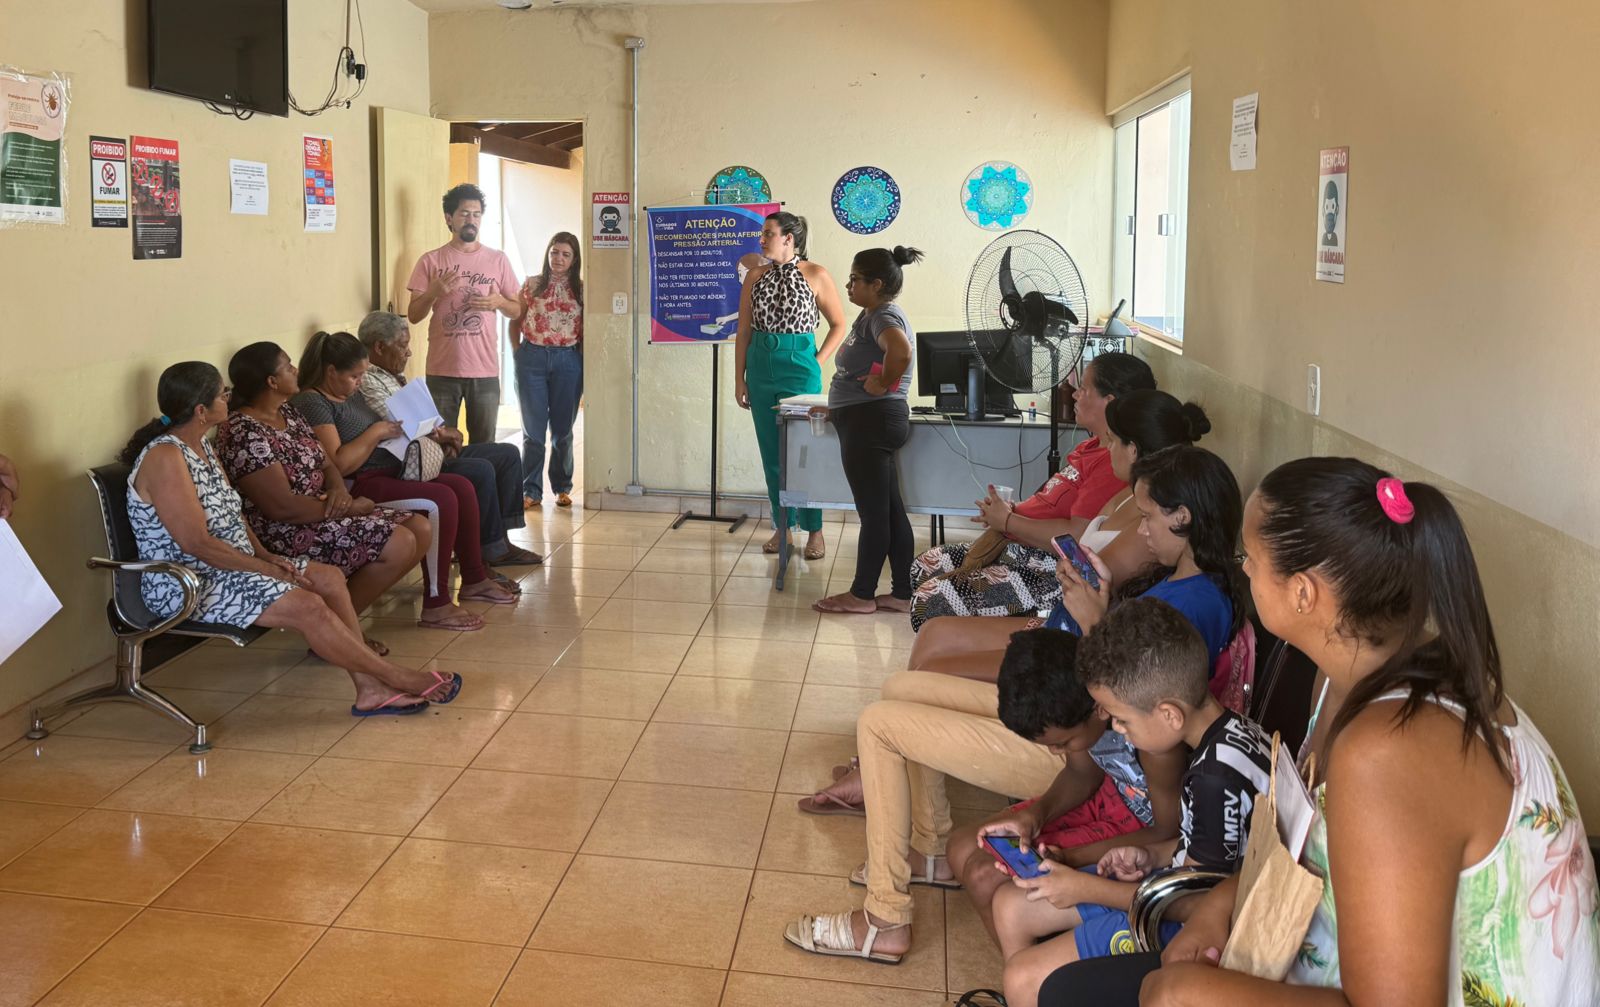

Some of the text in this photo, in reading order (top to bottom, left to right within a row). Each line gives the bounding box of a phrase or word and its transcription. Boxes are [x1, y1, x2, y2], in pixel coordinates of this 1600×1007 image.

[92, 143, 124, 156] PROIBIDO
[135, 144, 177, 156] PROIBIDO FUMAR
[99, 186, 120, 195] FUMAR
[594, 193, 629, 203] ATENÇÃO
[684, 217, 736, 230] ATENÇÃO
[654, 231, 717, 242] RECOMENDAÇÕES
[717, 232, 736, 240] PARA
[673, 239, 706, 248] PRESSÃO
[658, 293, 669, 301] NÃO
[1224, 788, 1240, 842] MRV
